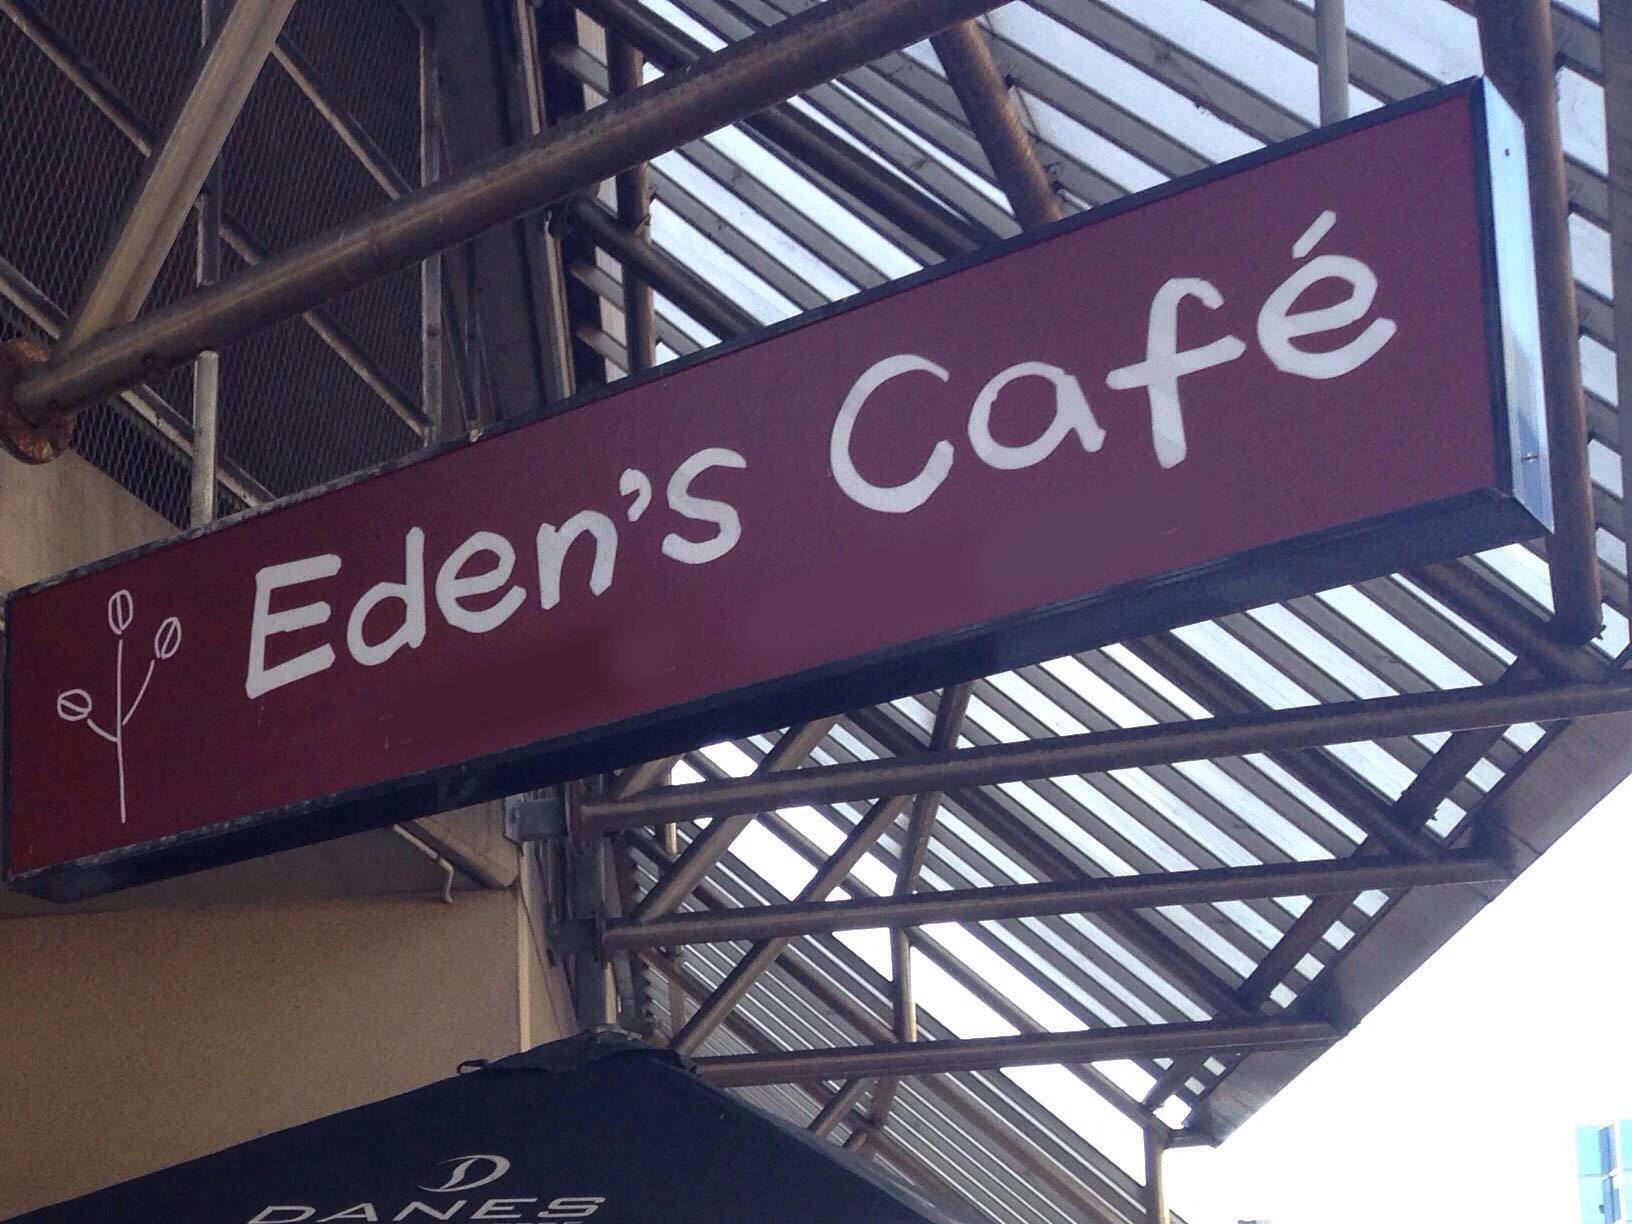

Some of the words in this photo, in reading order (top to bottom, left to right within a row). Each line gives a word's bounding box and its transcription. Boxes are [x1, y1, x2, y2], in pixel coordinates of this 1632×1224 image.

[245, 444, 746, 699] Eden's
[830, 210, 1397, 513] Café
[246, 1197, 606, 1224] DANES
